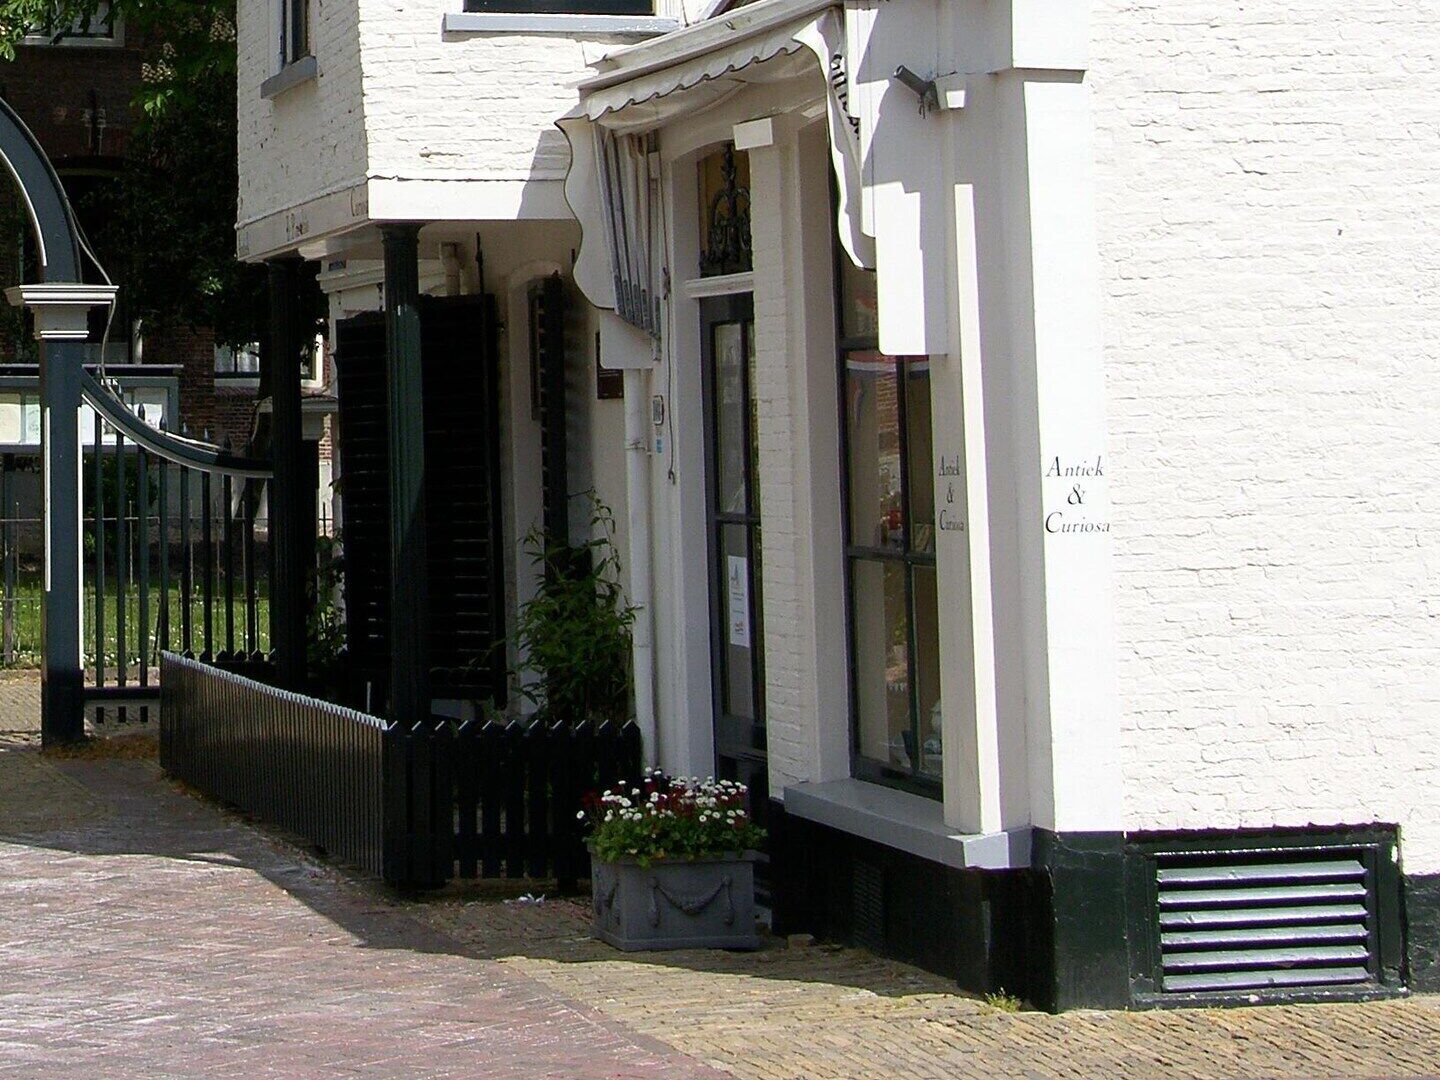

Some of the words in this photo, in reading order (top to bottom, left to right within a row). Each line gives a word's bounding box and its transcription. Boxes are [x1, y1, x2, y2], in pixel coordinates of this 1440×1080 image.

[1046, 455, 1105, 477] Antiek
[1067, 482, 1086, 505] &
[1045, 511, 1110, 533] Curiosa
